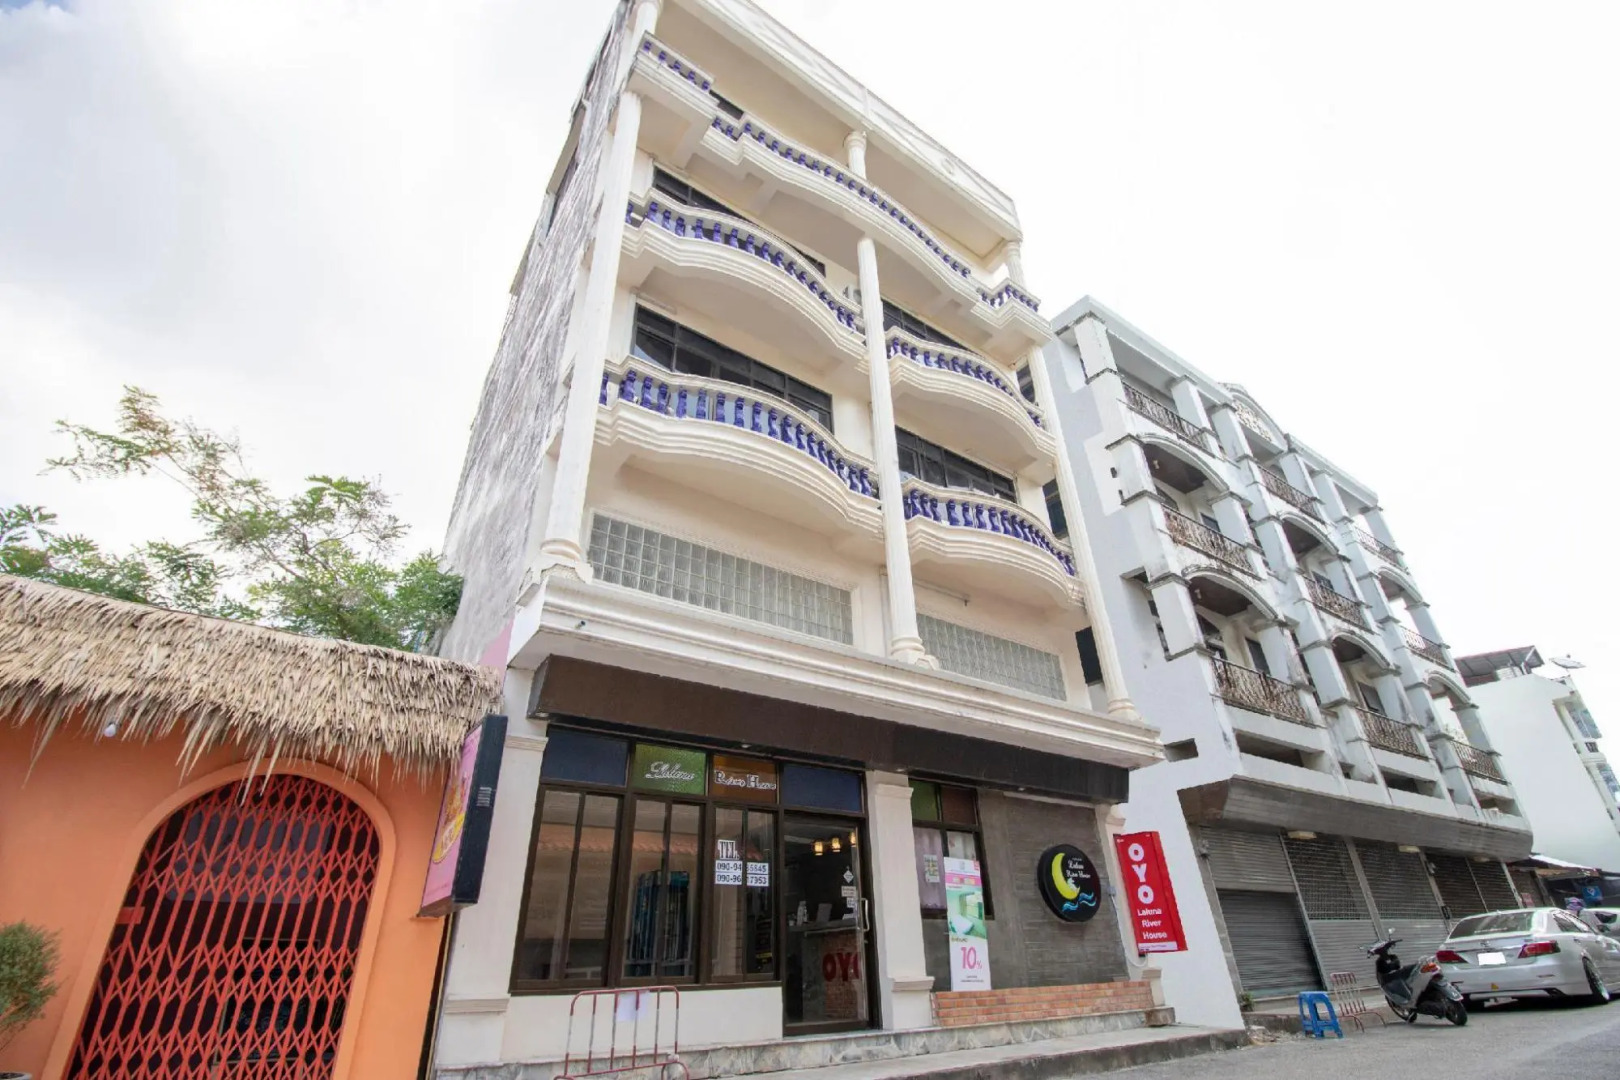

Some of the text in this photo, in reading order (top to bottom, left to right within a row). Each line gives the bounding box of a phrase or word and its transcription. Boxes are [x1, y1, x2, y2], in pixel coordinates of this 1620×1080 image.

[1128, 843, 1154, 904] OYO
[1141, 919, 1161, 928] River
[1143, 931, 1167, 940] House
